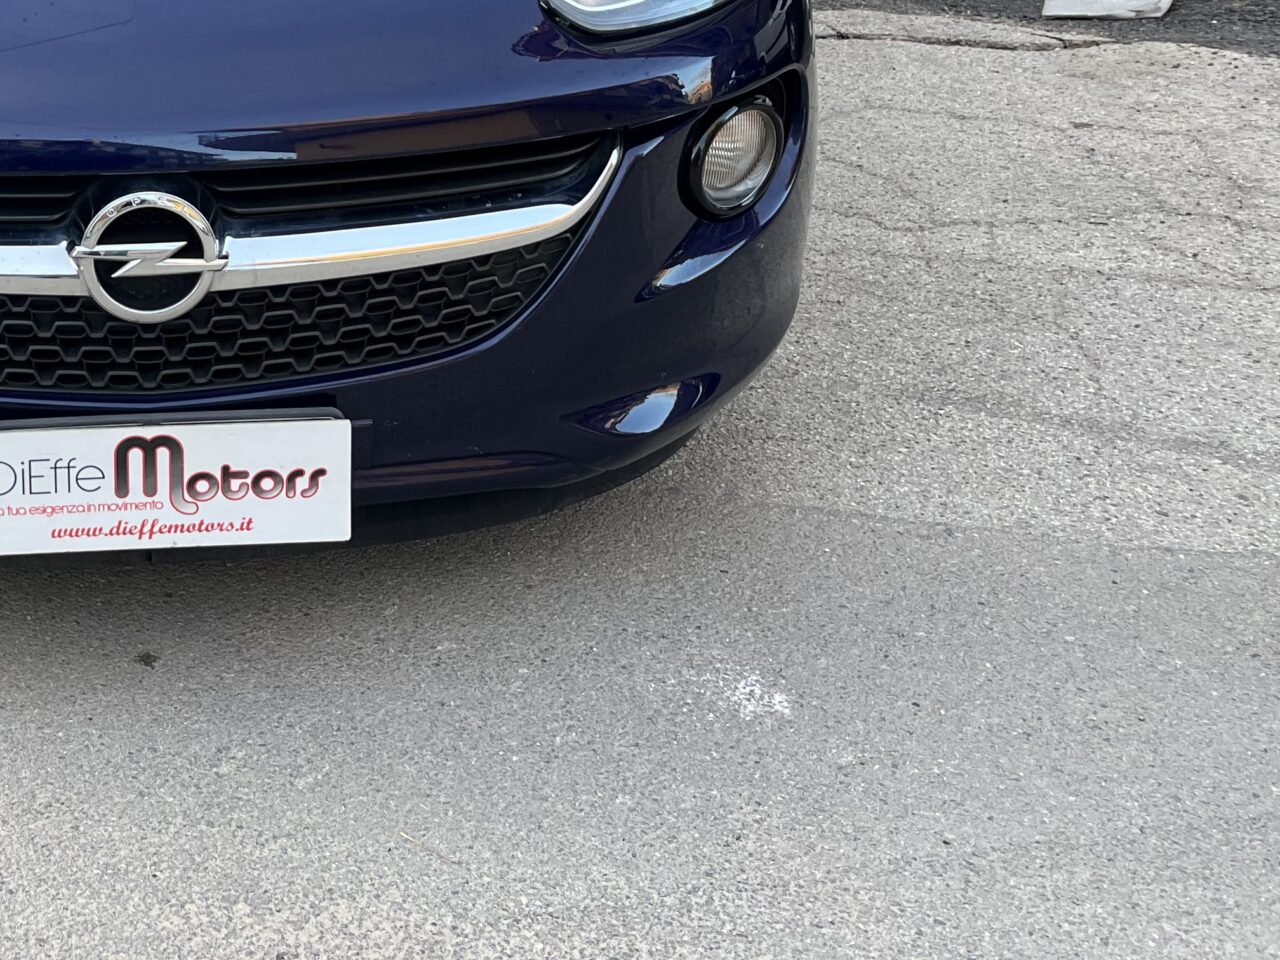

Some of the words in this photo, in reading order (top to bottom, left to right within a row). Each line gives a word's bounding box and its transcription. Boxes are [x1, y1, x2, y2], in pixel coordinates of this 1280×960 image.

[7, 505, 27, 516] tua
[29, 502, 87, 518] esigenza
[98, 499, 164, 513] movimento
[50, 516, 255, 542] www.dieffemotors.it
